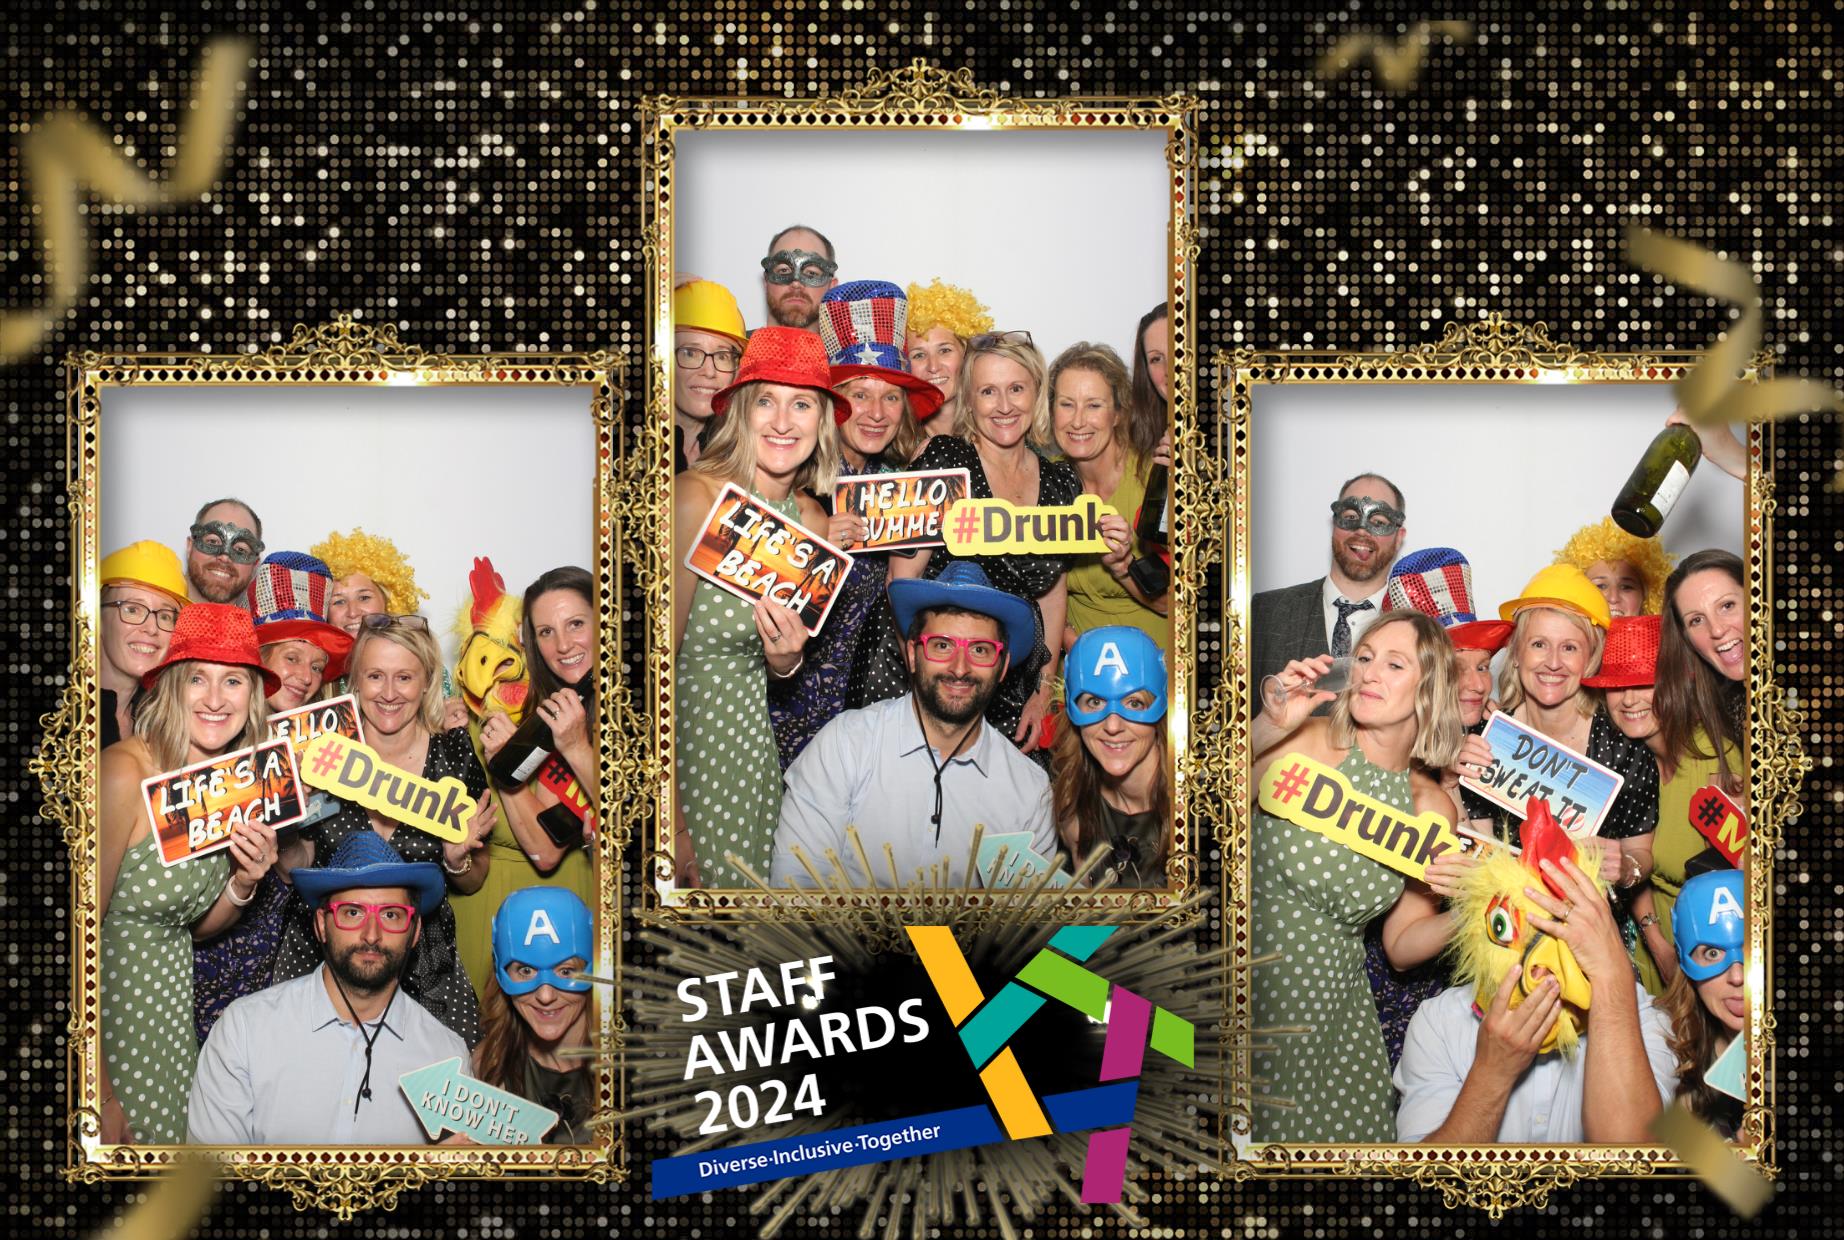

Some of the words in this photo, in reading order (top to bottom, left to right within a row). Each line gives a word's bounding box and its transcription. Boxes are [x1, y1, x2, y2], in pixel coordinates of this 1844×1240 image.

[860, 478, 947, 511] HELLO
[719, 500, 814, 569] LIFE'S
[811, 558, 836, 585] A
[953, 501, 1111, 545] #Drunk
[716, 549, 813, 614] BEACH
[1093, 641, 1129, 676] A
[159, 760, 256, 816] LIFE'S
[262, 751, 282, 780] A
[1511, 733, 1588, 789] DON'T
[311, 739, 470, 832] #Drunk
[188, 792, 281, 848] BEACH
[1271, 762, 1453, 866] #Drunk
[1551, 796, 1588, 830] IT
[523, 909, 561, 946] A
[1708, 886, 1744, 925] A
[421, 1090, 485, 1130] KNOW
[441, 1078, 451, 1096] I
[454, 1084, 520, 1124] DON'T
